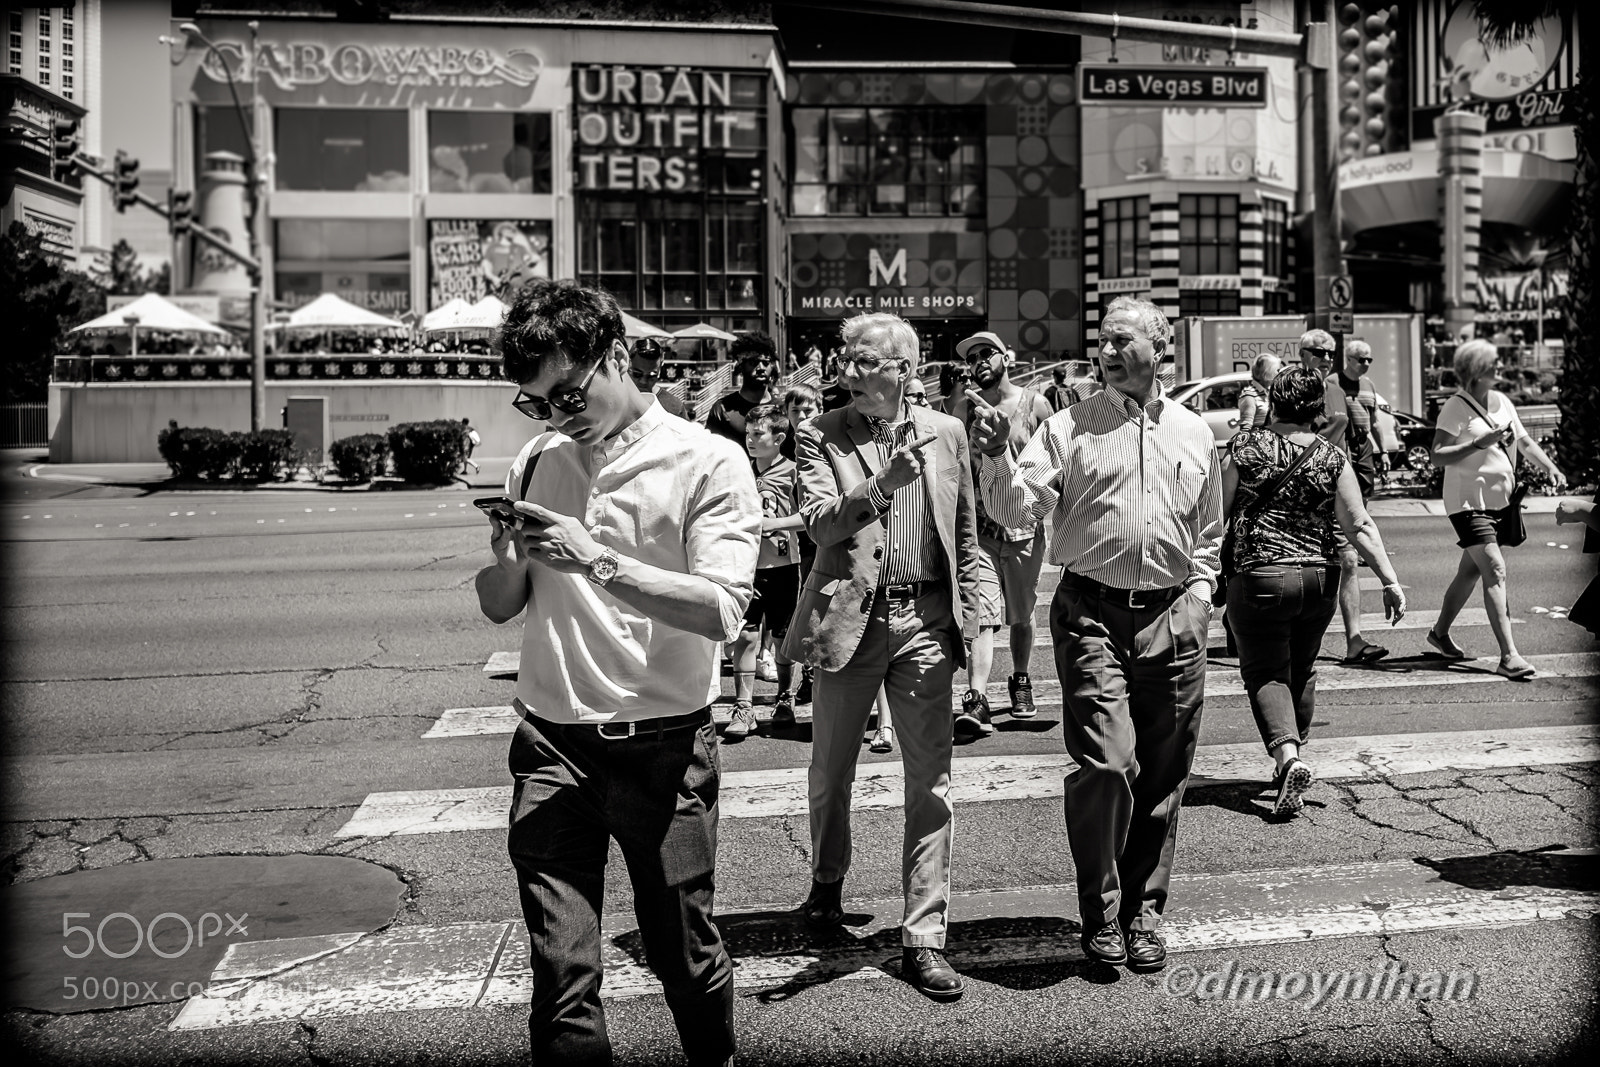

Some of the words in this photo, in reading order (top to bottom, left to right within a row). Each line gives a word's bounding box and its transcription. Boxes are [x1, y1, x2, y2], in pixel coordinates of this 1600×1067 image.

[202, 41, 376, 91] CABO
[374, 45, 515, 82] WABO
[386, 75, 503, 88] CANTINA
[577, 67, 731, 106] URBAN
[1089, 74, 1130, 94] Las
[1137, 75, 1203, 100] Vegas
[1211, 76, 1259, 96] Blvd
[1495, 103, 1513, 121] a
[1516, 93, 1564, 126] Girl
[578, 109, 738, 148] OUTFIT
[868, 247, 908, 287] M
[802, 296, 872, 310] MIRACLE
[880, 296, 915, 309] MILE
[922, 295, 975, 308] SHOPS
[1232, 342, 1264, 359] BEST
[1267, 342, 1301, 358] SEAT
